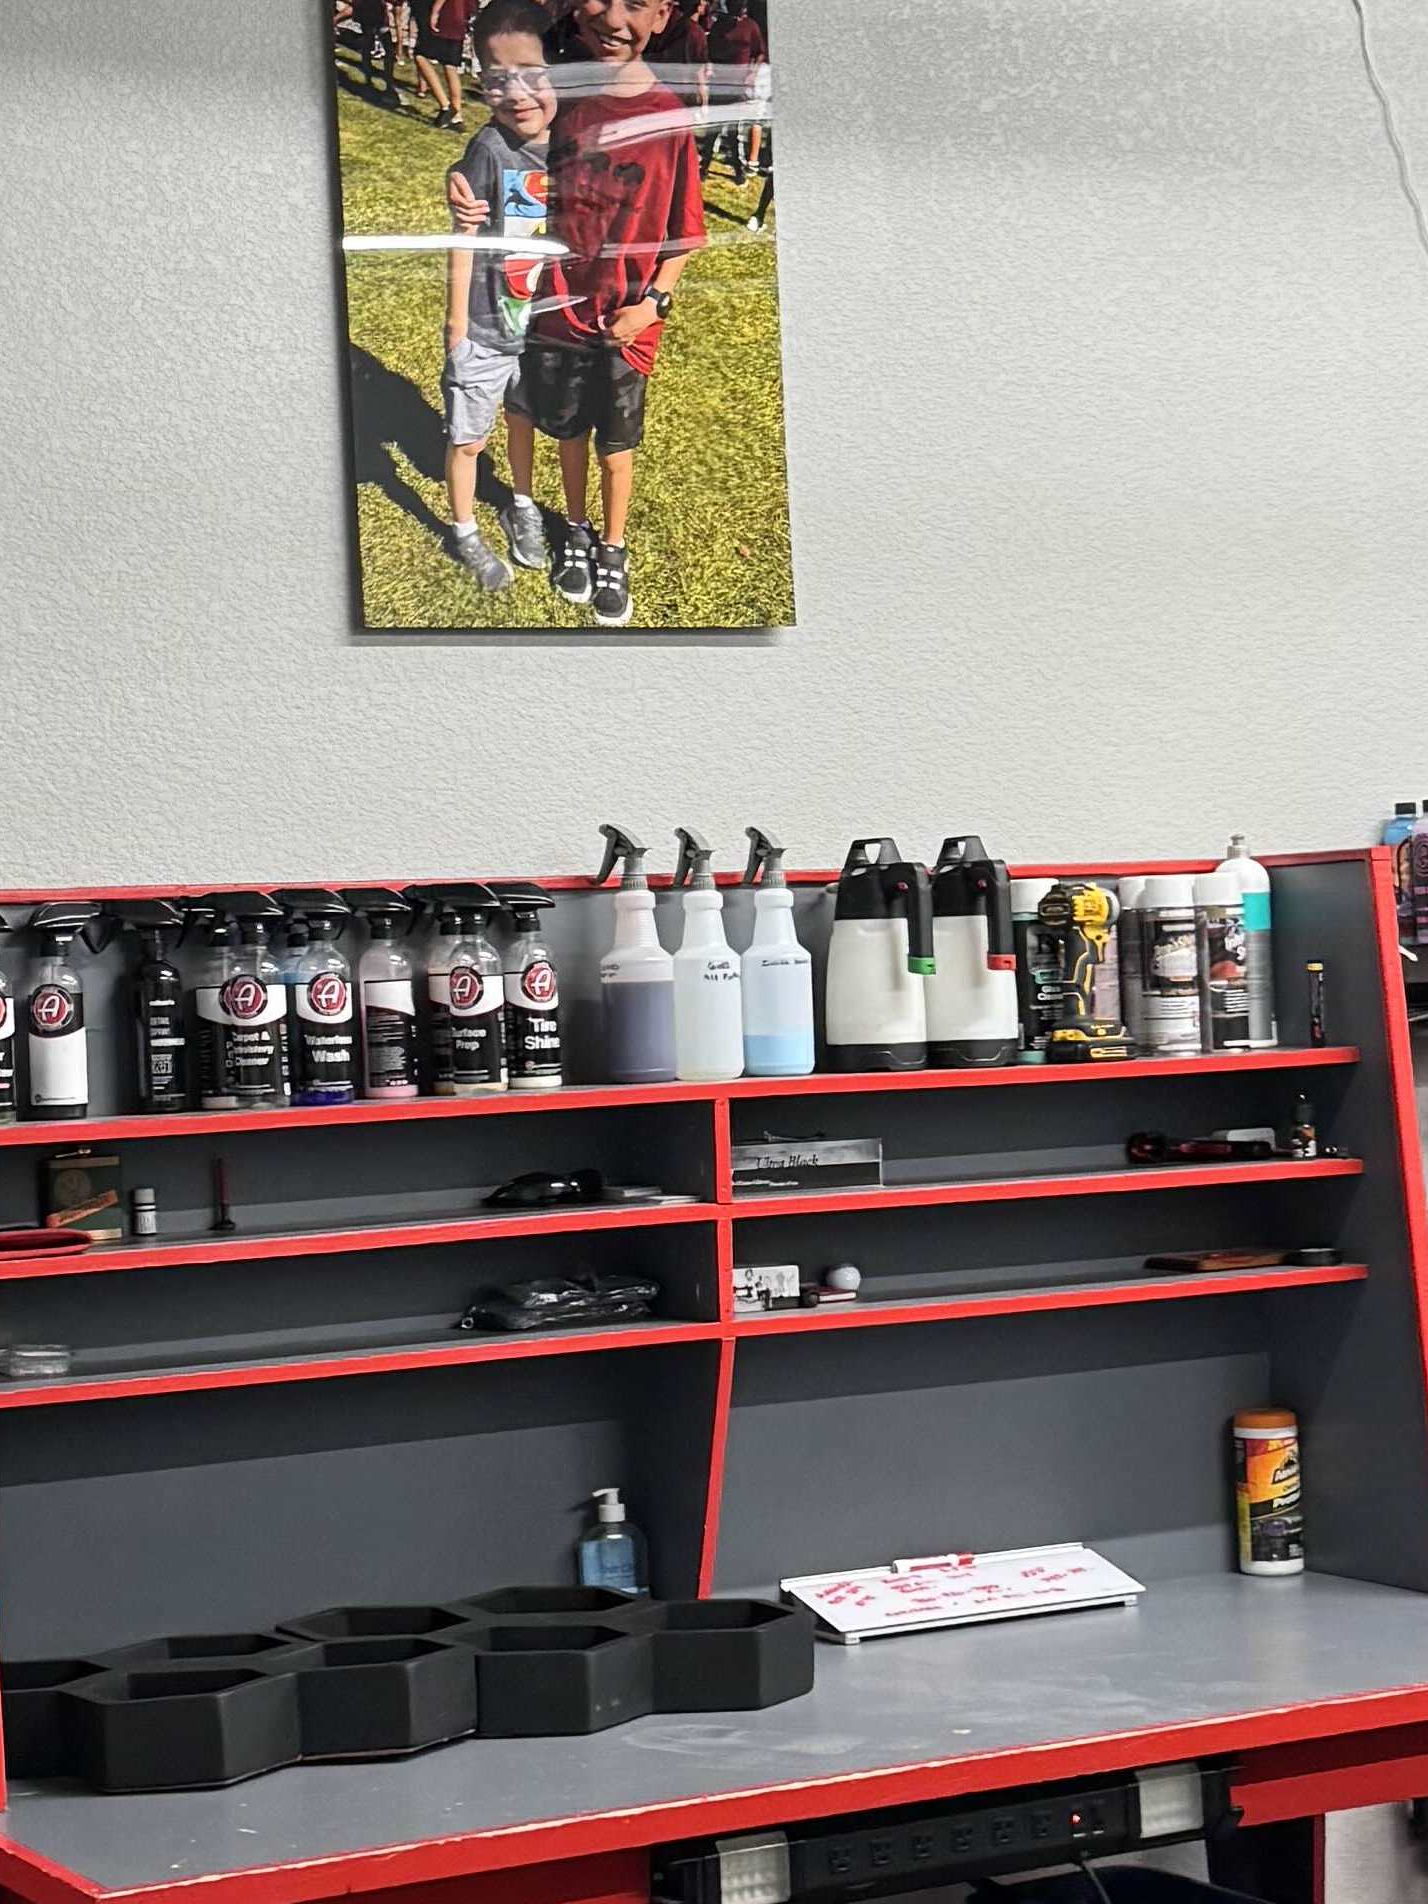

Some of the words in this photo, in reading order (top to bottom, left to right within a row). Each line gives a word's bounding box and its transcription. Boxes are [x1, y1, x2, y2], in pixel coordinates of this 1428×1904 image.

[316, 979, 340, 1007] A
[452, 975, 472, 1000] A
[530, 969, 552, 995] A
[37, 995, 60, 1021] A
[233, 983, 256, 1010] A
[312, 1049, 350, 1062] Wash
